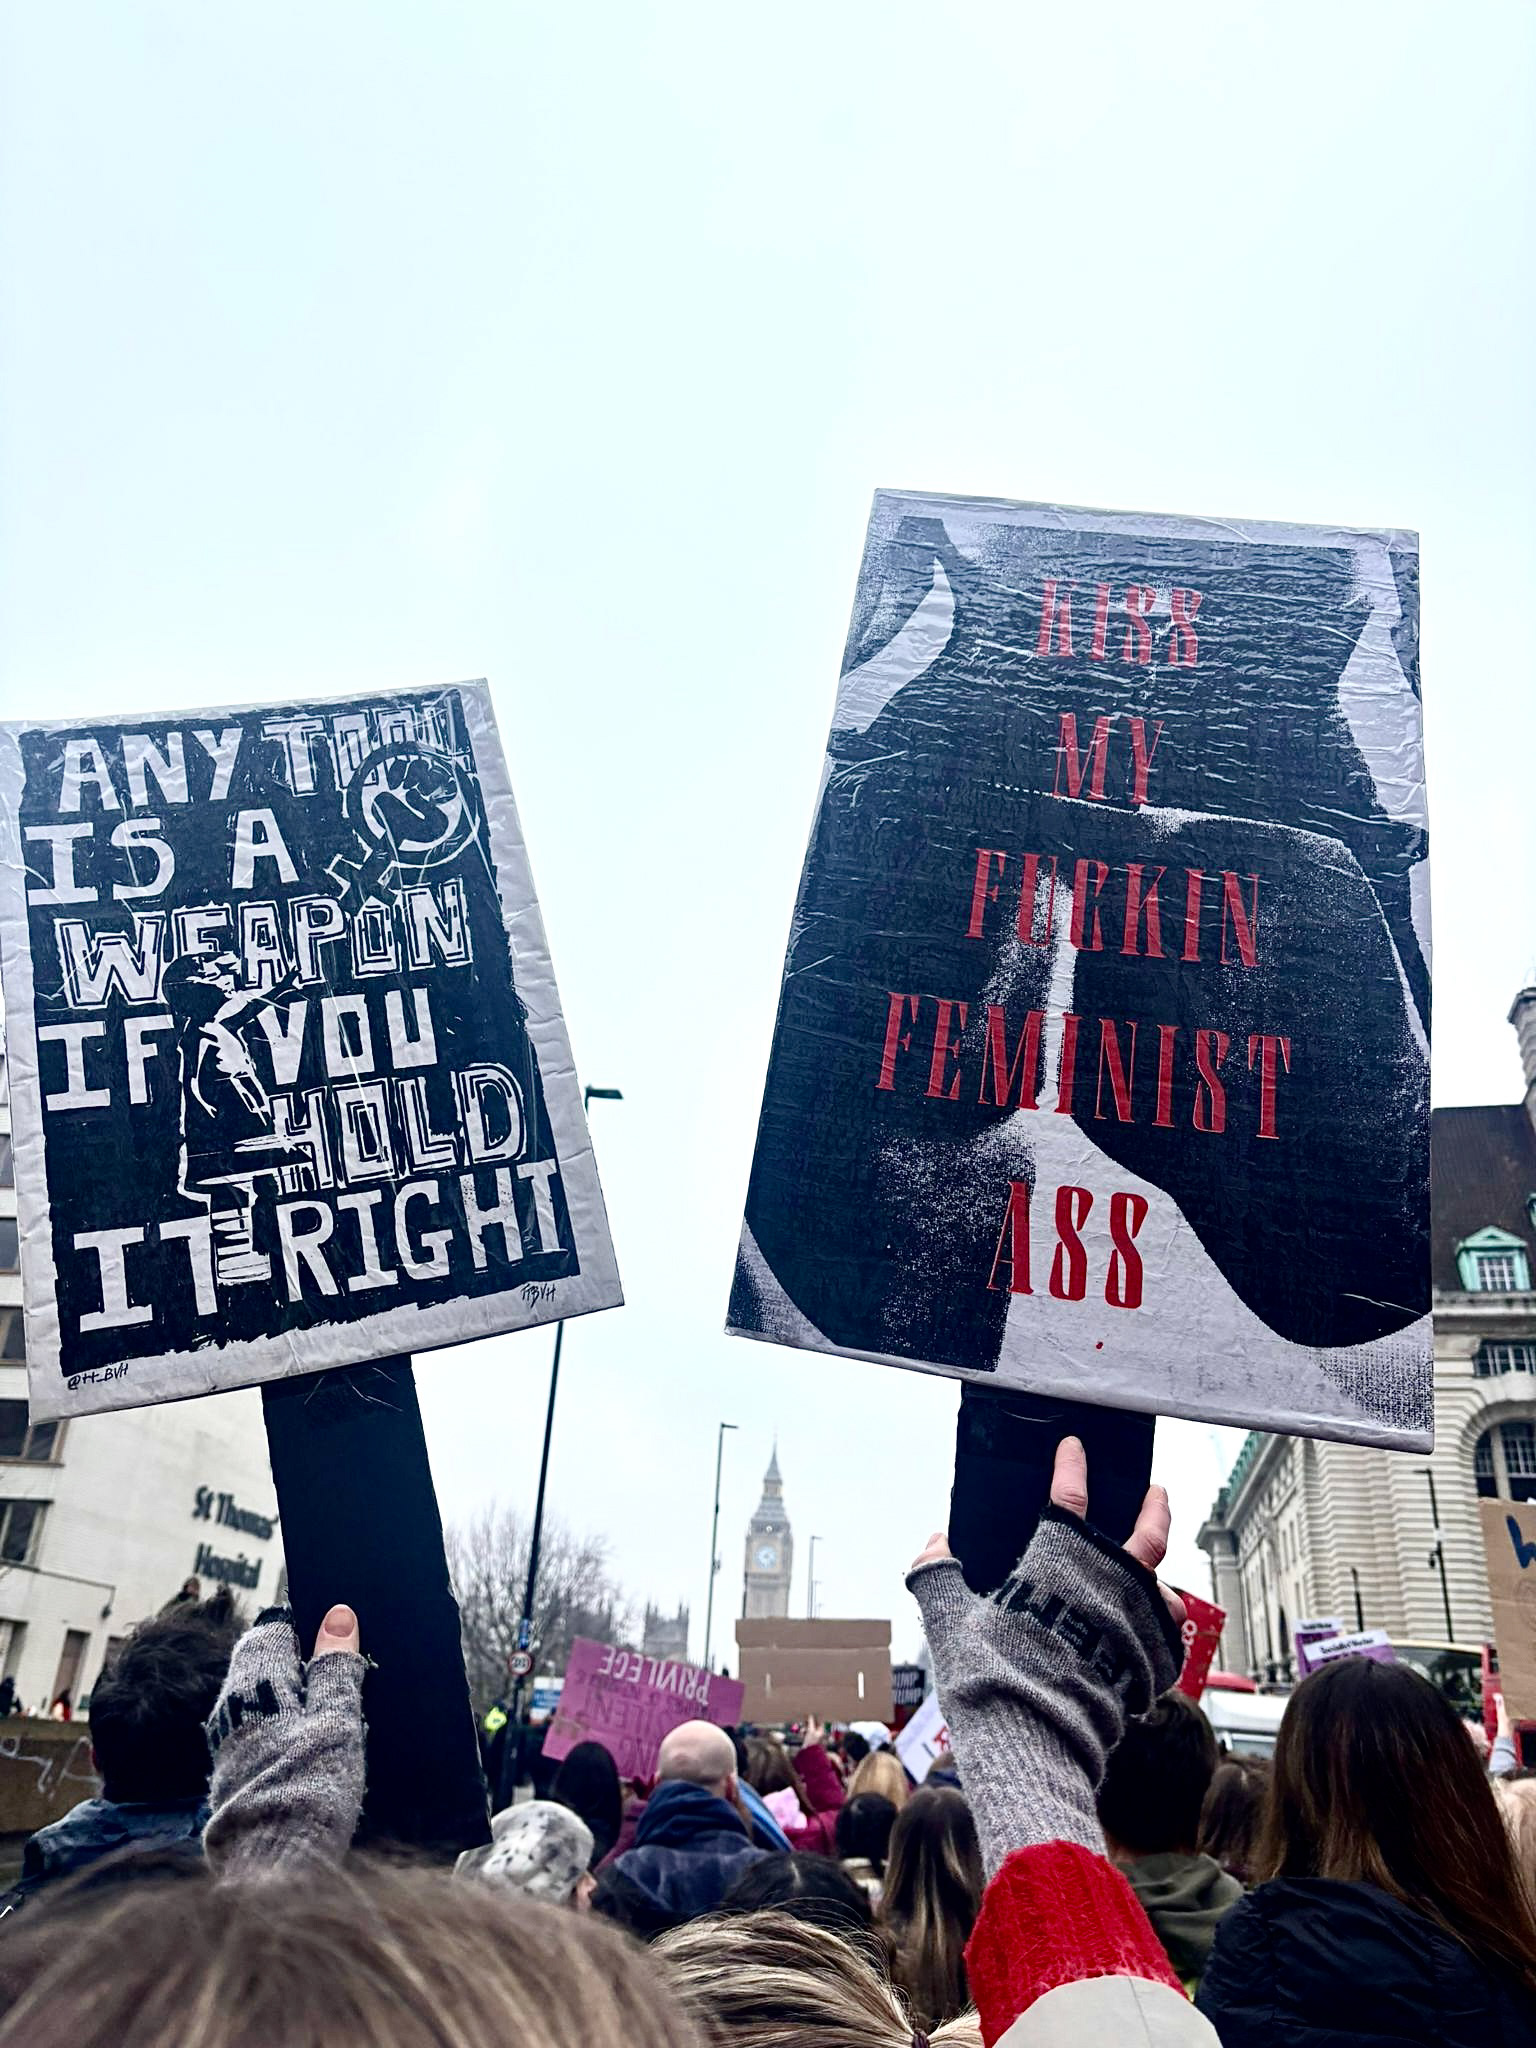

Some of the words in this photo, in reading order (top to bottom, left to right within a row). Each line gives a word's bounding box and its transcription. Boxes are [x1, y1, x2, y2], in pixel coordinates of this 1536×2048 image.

[1036, 579, 1202, 668] KISS
[58, 727, 244, 813] ANY
[1052, 712, 1165, 804] MY
[24, 816, 176, 906] IS
[232, 808, 299, 890] A
[965, 847, 1261, 968] FUCKIN
[53, 878, 472, 1009] WEAPON
[37, 1012, 175, 1112] IF
[257, 987, 437, 1086] YOU
[875, 991, 1292, 1141] FEMINIST
[268, 1062, 528, 1191] HOLD
[73, 1213, 219, 1332] IT
[275, 1159, 570, 1303] RIGHT
[986, 1180, 1150, 1309] ASS
[598, 1644, 711, 1706] PRIVILEGE
